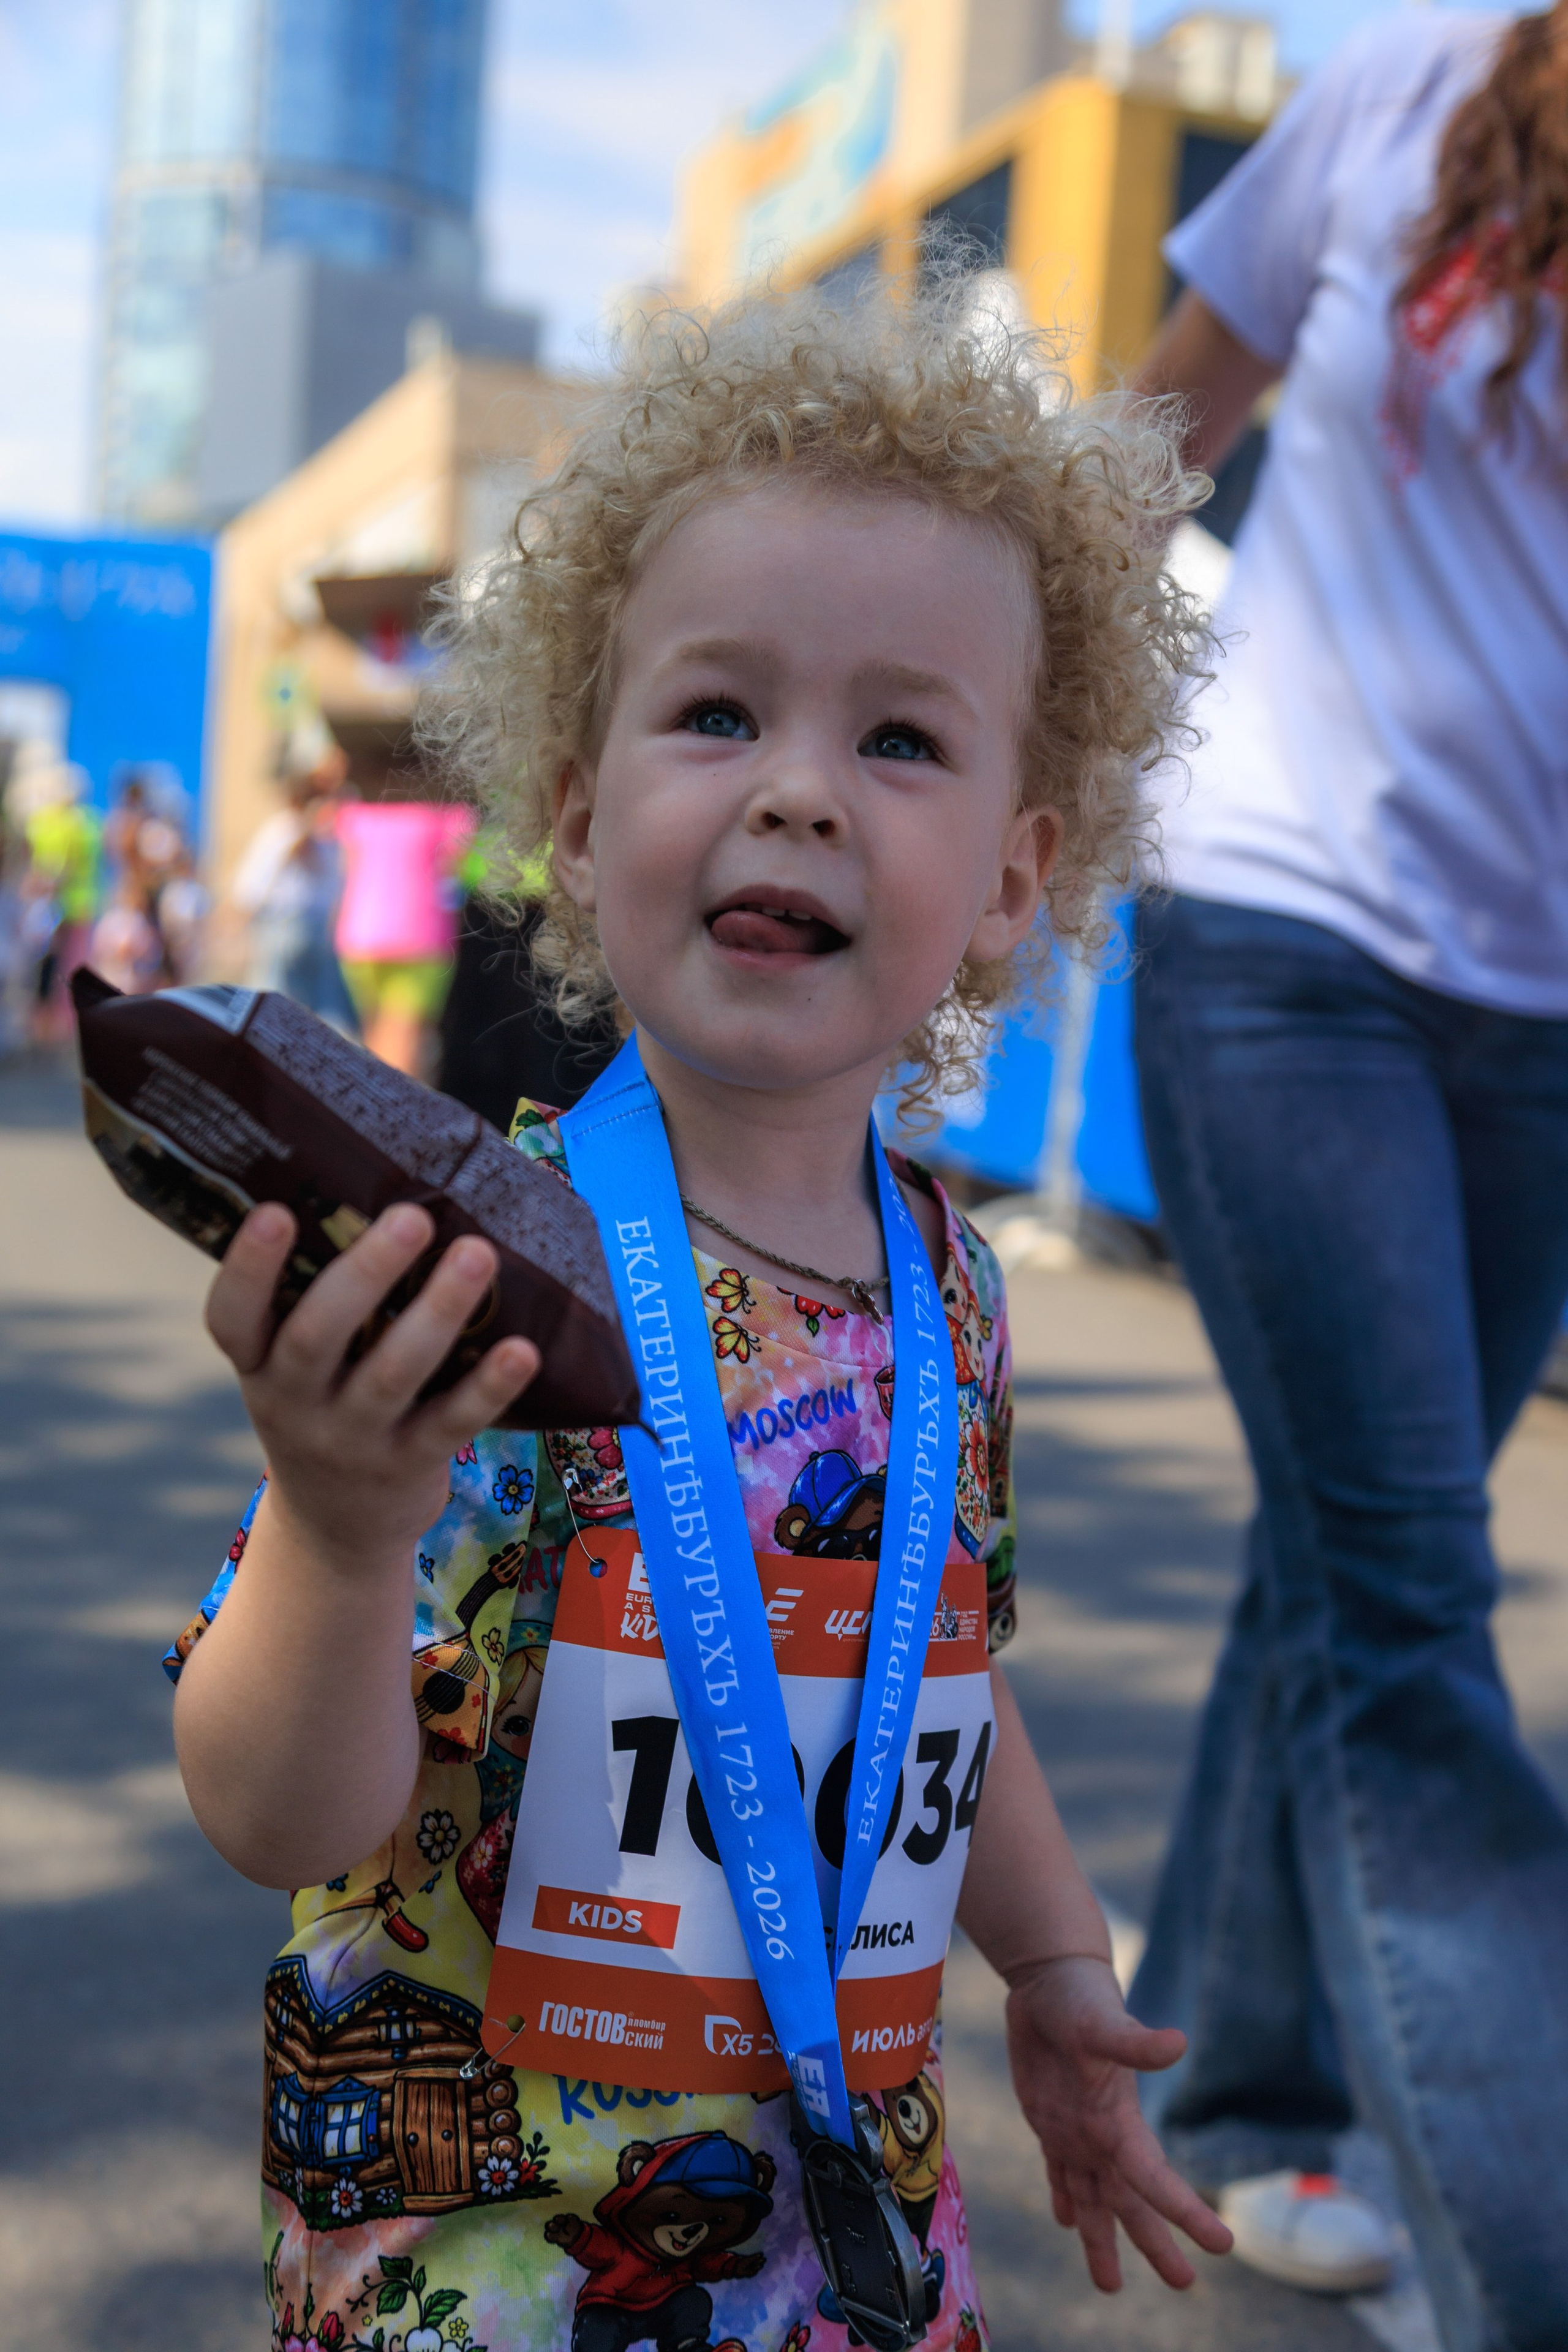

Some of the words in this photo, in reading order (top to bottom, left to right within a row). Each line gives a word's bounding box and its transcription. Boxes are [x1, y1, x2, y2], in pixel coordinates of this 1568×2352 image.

[910, 1262, 937, 1347] 1723
[727, 1378, 857, 1450] MOSCOW
[625, 1593, 652, 1604] EUR
[620, 1611, 660, 1642] KID
[769, 1627, 795, 1636] ВЛЕНИЕ
[715, 1722, 764, 1821] 1723
[747, 1861, 795, 1961] 2026
[568, 1901, 643, 1934] KIDS
[848, 1920, 914, 1950] ЛИСА
[538, 2001, 627, 2045] ГОСТОВ
[627, 2018, 666, 2032] пломбир
